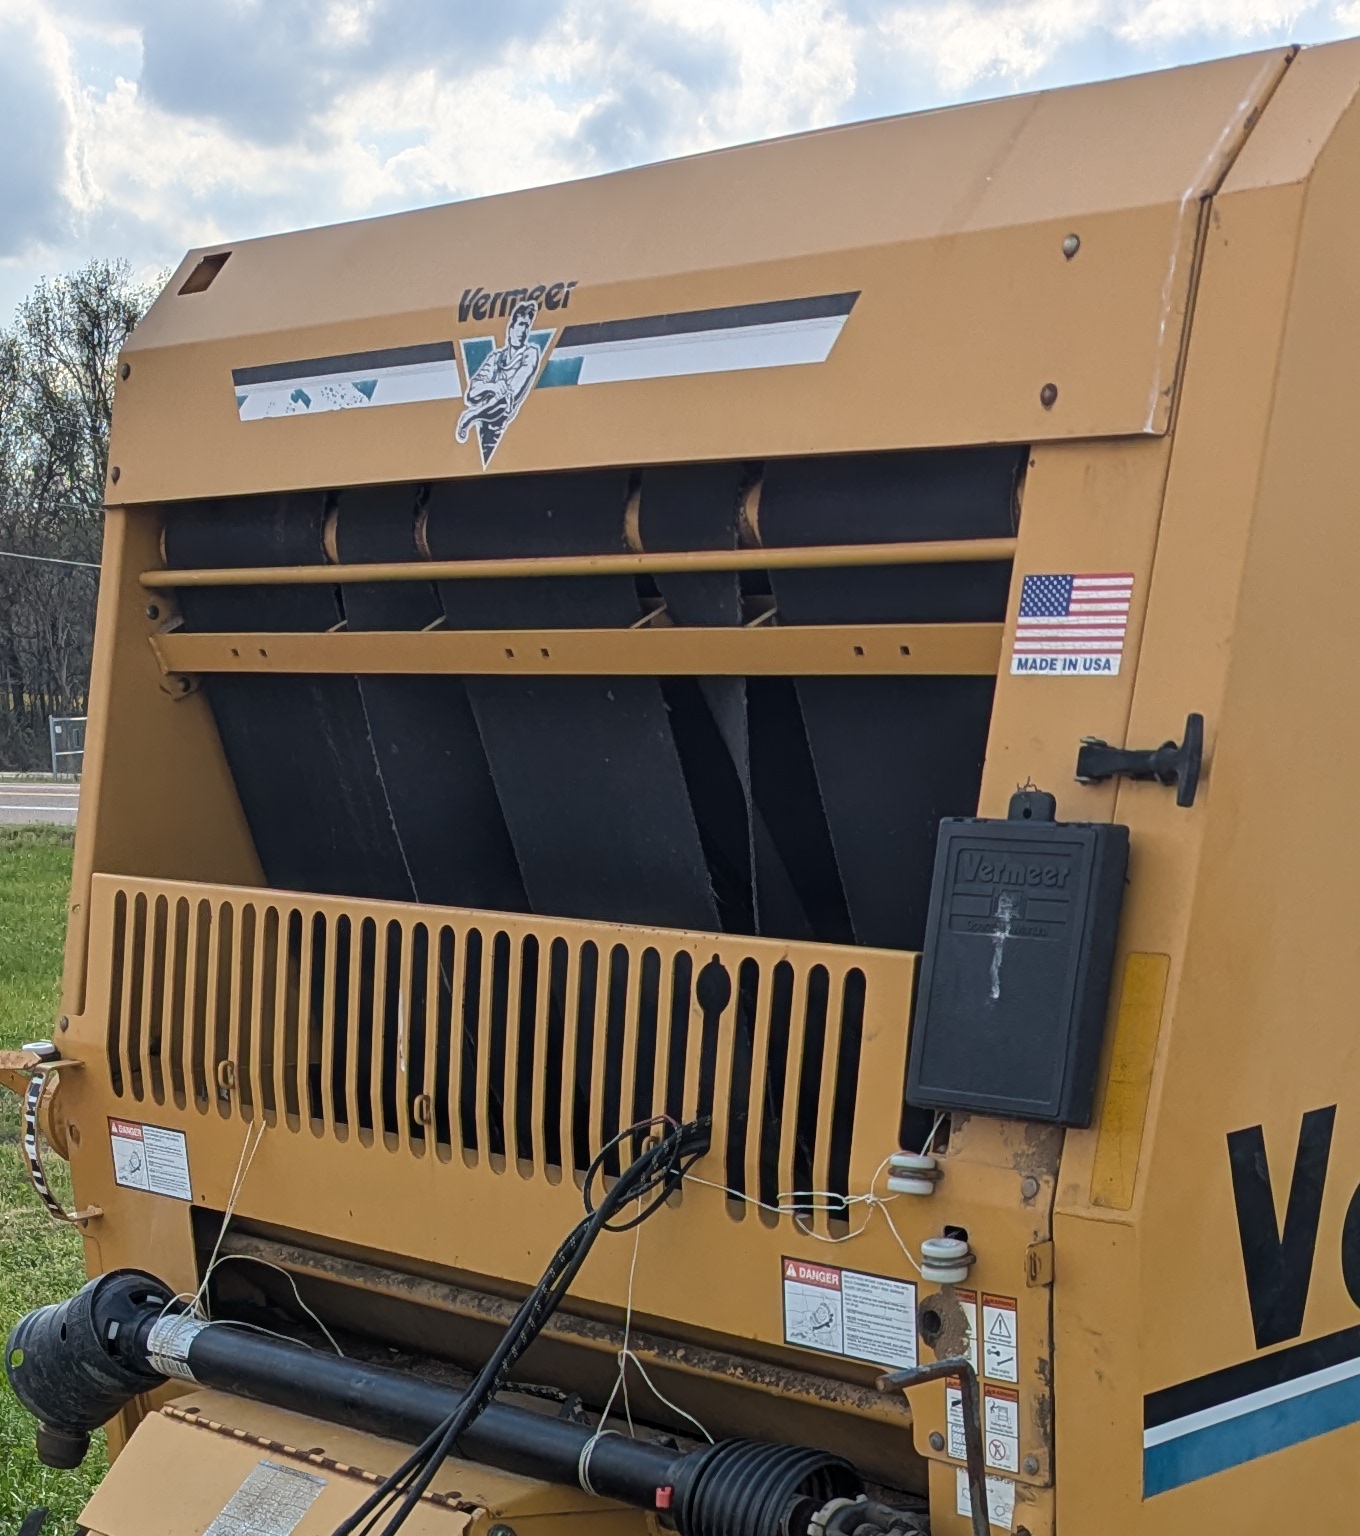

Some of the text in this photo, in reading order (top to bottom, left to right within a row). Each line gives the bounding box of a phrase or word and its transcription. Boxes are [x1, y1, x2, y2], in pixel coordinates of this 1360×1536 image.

[458, 280, 579, 323] Vermeer
[1016, 657, 1112, 671] MADE IN USA
[961, 851, 1071, 889] Vermeer
[799, 1266, 839, 1286] DANGER
